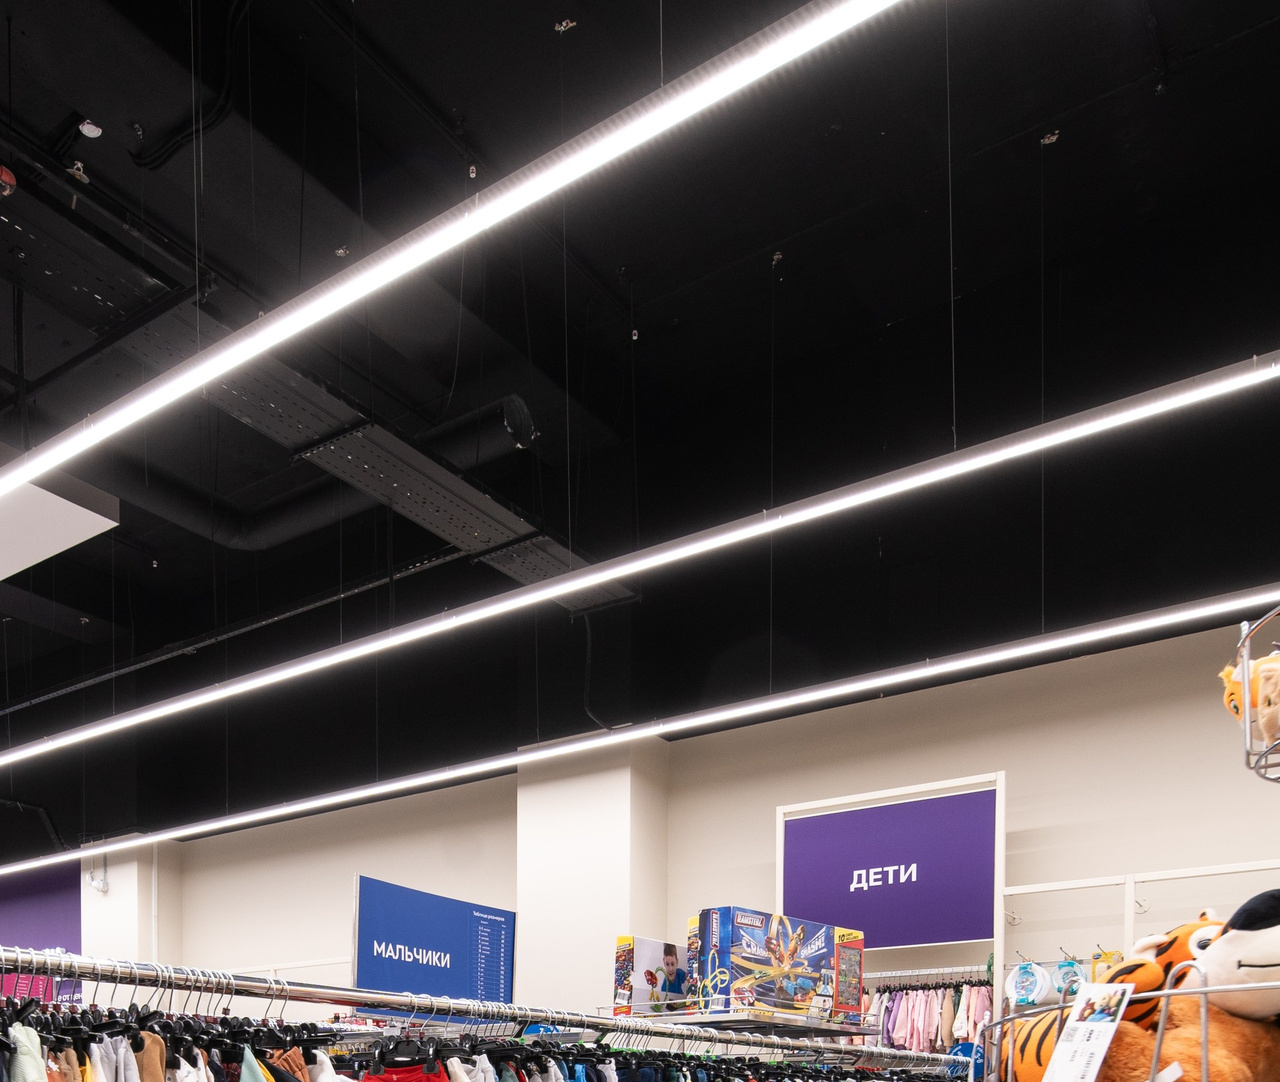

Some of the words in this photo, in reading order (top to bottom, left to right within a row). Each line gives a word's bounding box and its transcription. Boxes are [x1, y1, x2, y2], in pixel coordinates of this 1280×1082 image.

[849, 863, 918, 892] ДЕТИ
[838, 933, 846, 943] 10
[373, 939, 451, 969] МАЛЬЧИКИ
